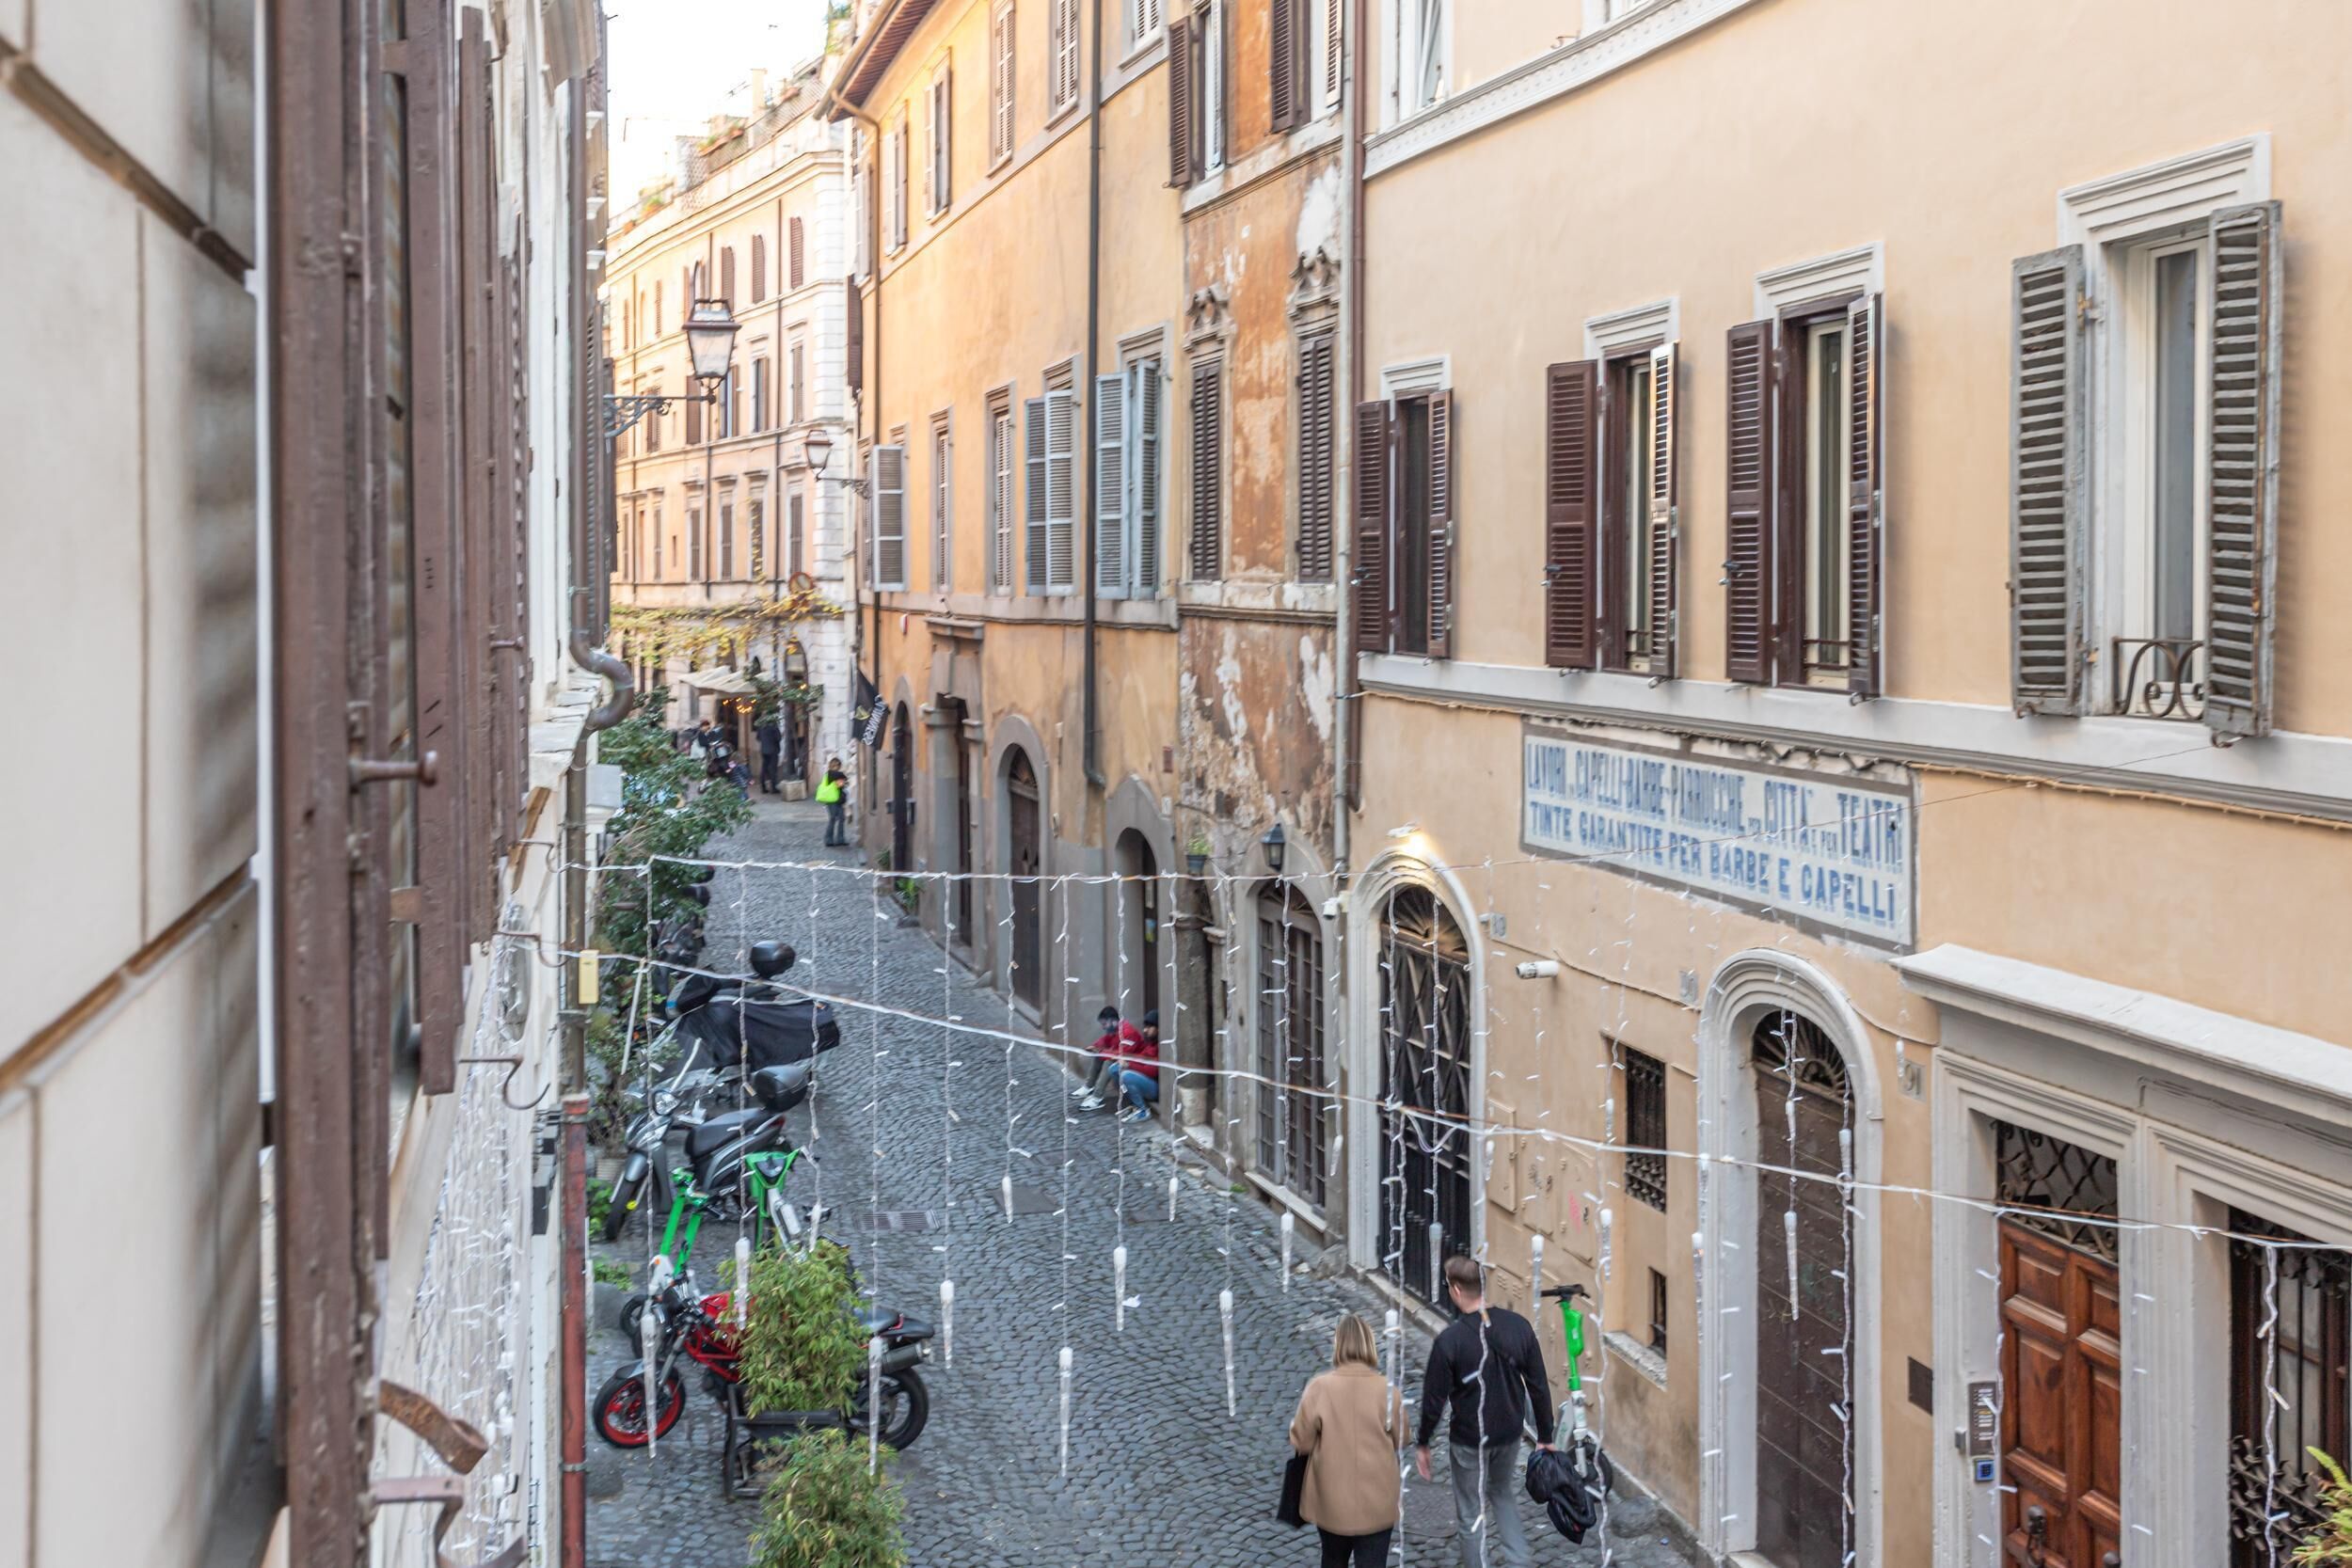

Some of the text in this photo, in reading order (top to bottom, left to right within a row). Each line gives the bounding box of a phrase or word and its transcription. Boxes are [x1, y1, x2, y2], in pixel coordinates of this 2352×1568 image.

[1530, 800, 1895, 922] TINTE GARANTITE PER BARBE E CAPELLI
[1821, 831, 1838, 853] PER
[1837, 793, 1902, 865] TEATRI
